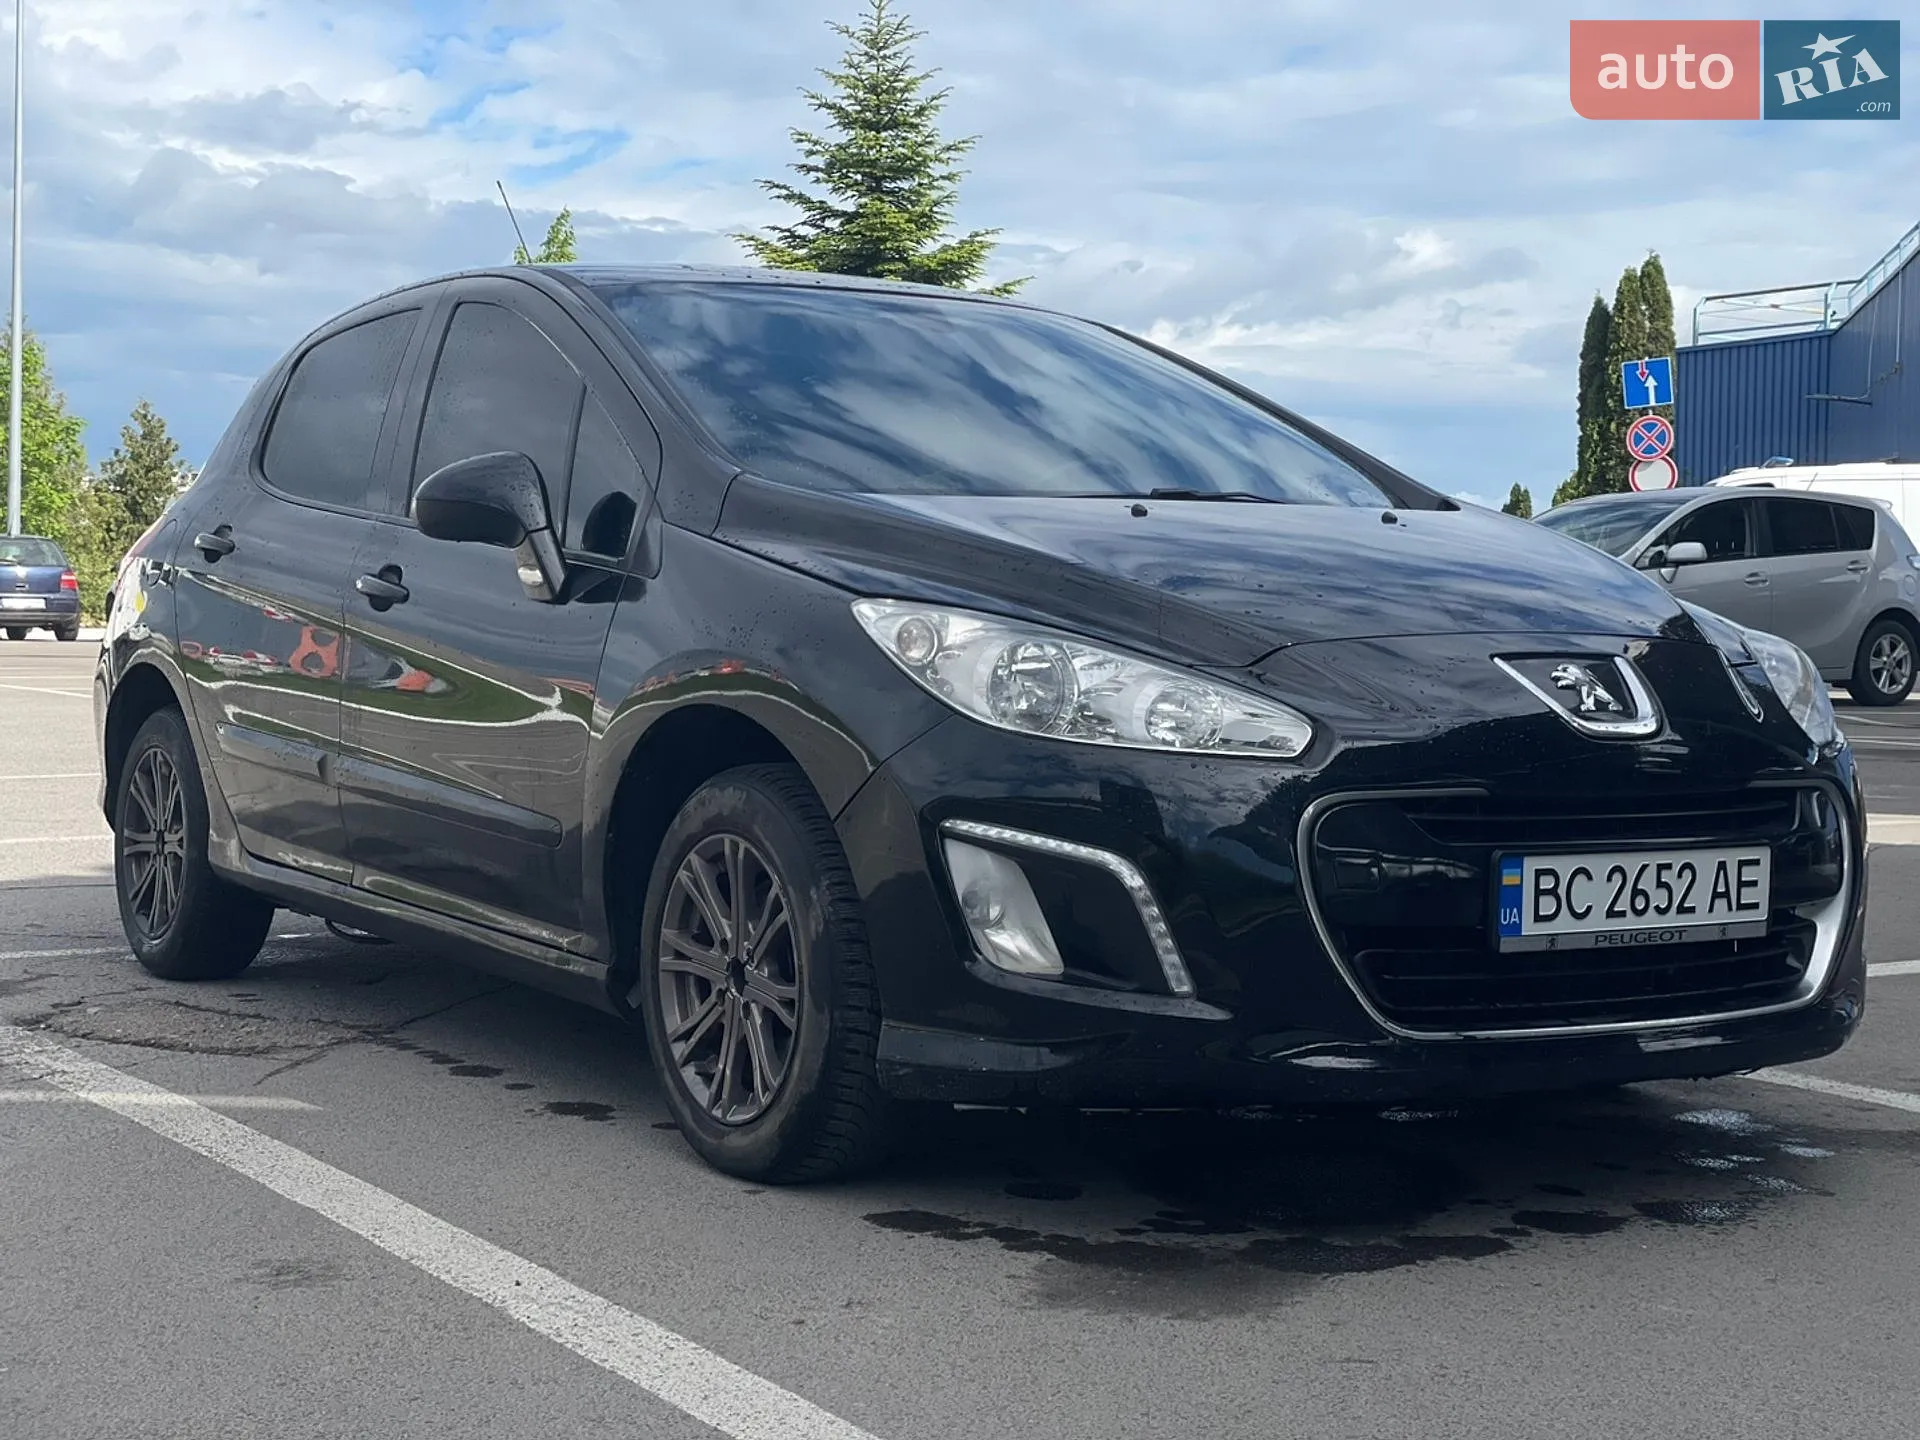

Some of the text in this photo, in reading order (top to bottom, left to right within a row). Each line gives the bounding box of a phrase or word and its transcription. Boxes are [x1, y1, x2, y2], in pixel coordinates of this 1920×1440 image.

[1533, 856, 1762, 924] BC 2652 AE
[1500, 906, 1520, 925] UA
[1594, 929, 1689, 947] PEUGEOT
